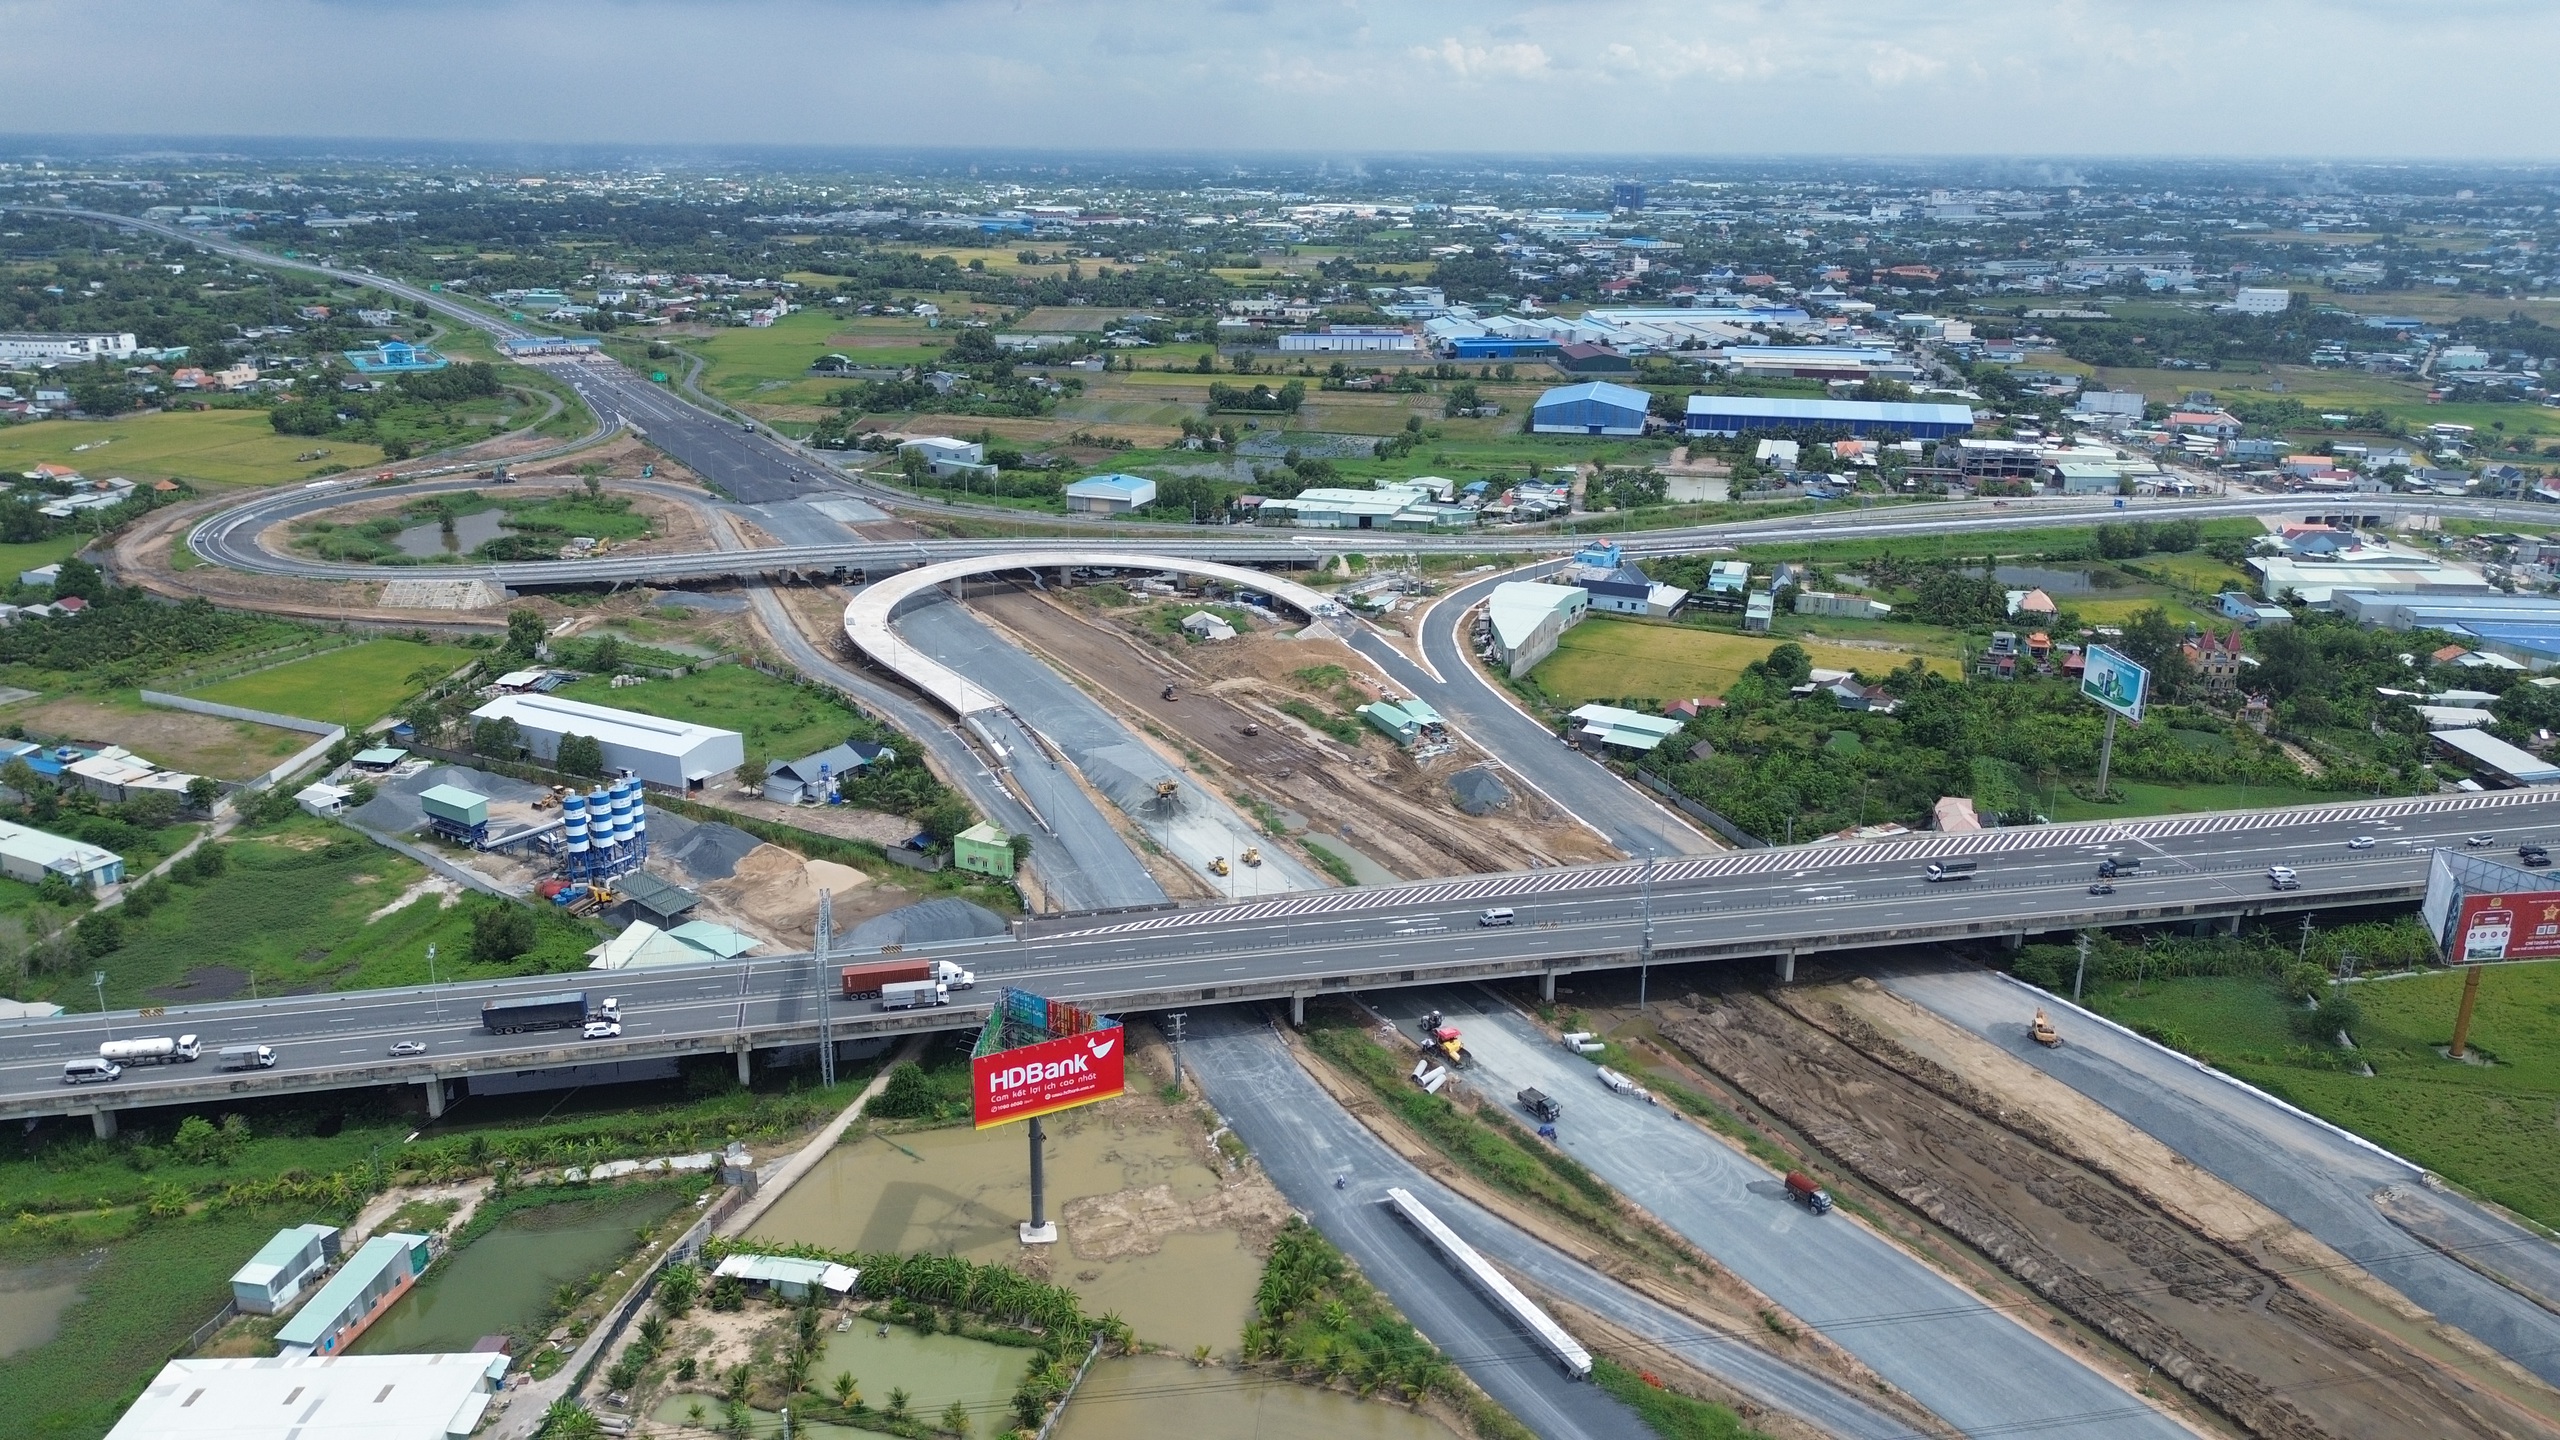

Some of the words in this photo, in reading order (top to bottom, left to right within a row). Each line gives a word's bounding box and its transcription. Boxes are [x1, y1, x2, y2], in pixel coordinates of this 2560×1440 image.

[990, 1054, 1088, 1092] HDBank
[990, 1094, 1009, 1103] Cam
[1012, 1089, 1026, 1098] kết
[1030, 1086, 1040, 1095] lợi
[1044, 1082, 1056, 1091] ích
[1060, 1078, 1074, 1087] cao
[1078, 1072, 1096, 1083] nhất
